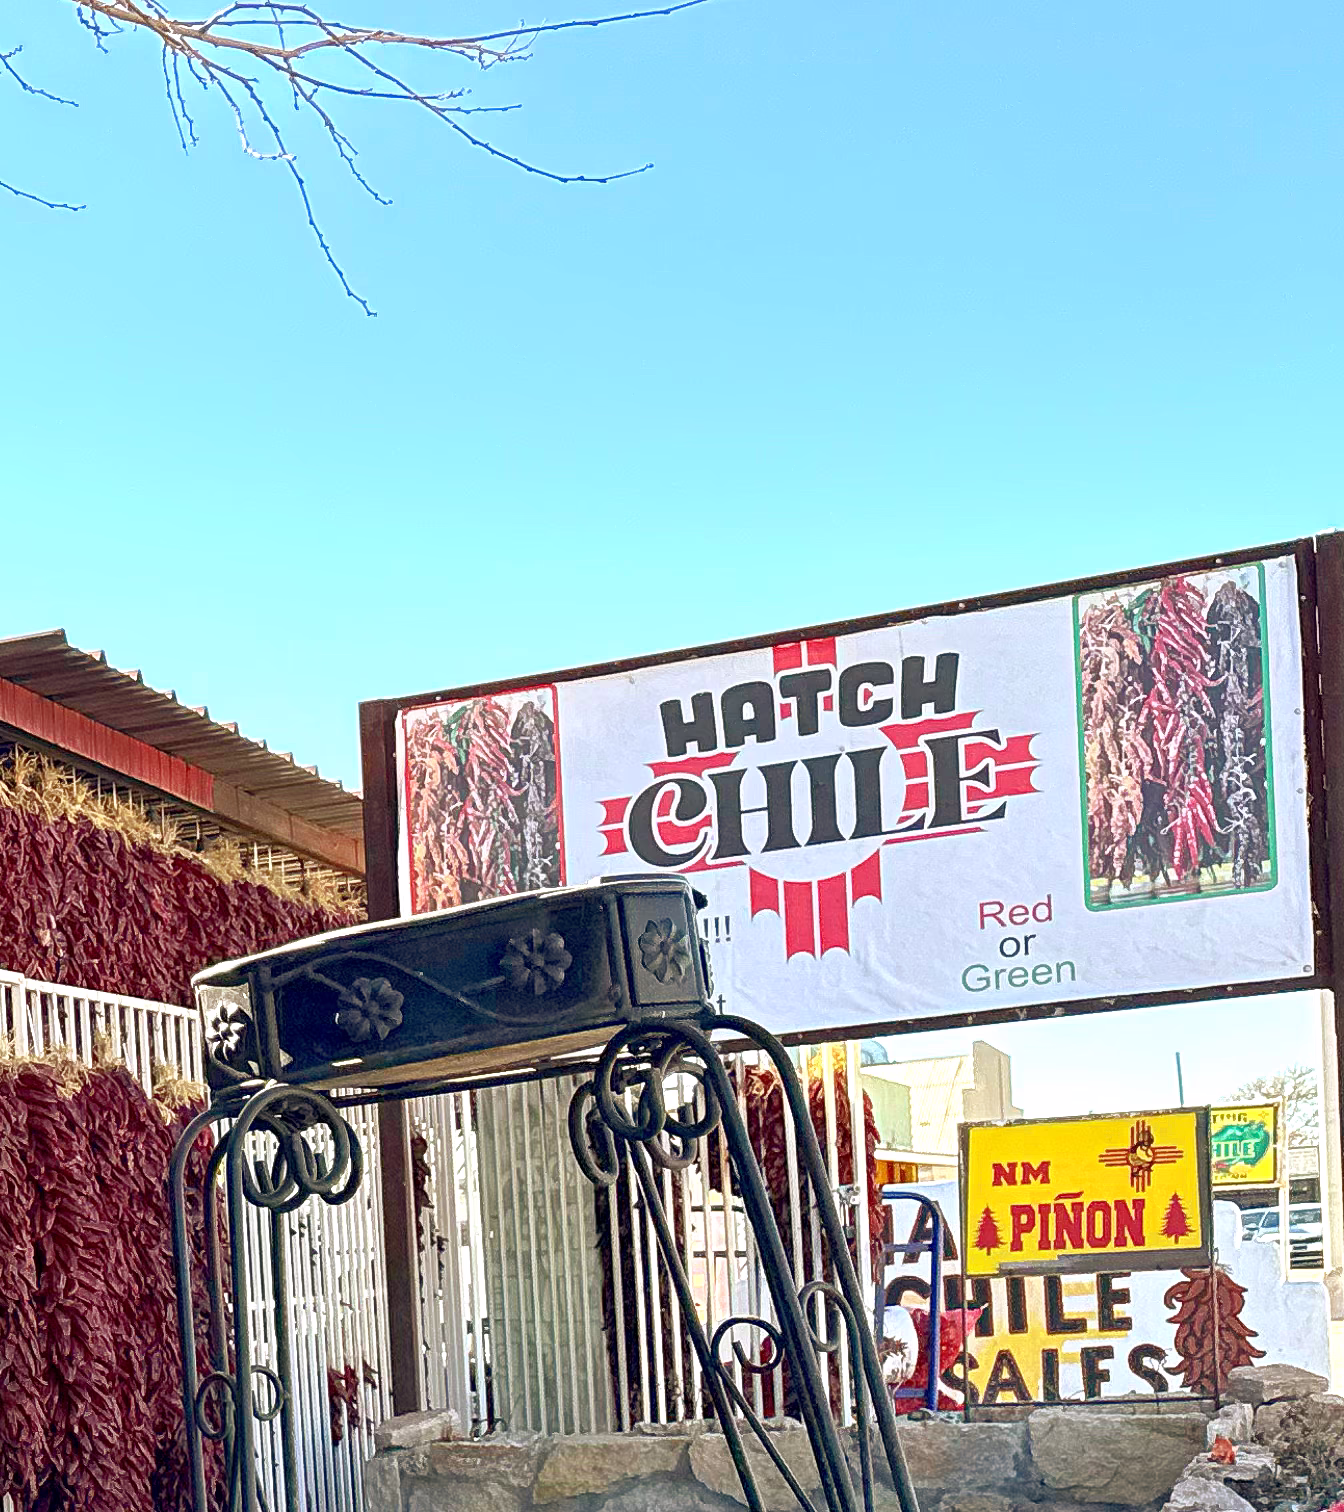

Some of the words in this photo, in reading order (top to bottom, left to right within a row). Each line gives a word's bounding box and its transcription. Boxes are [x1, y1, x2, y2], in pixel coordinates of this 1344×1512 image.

[660, 652, 960, 757] HATCH
[628, 728, 1008, 868] CHILE
[979, 893, 1053, 930] Red
[999, 933, 1037, 958] or
[961, 961, 1077, 993] Green
[992, 1160, 1051, 1187] NM
[1010, 1190, 1146, 1252] PIÑON
